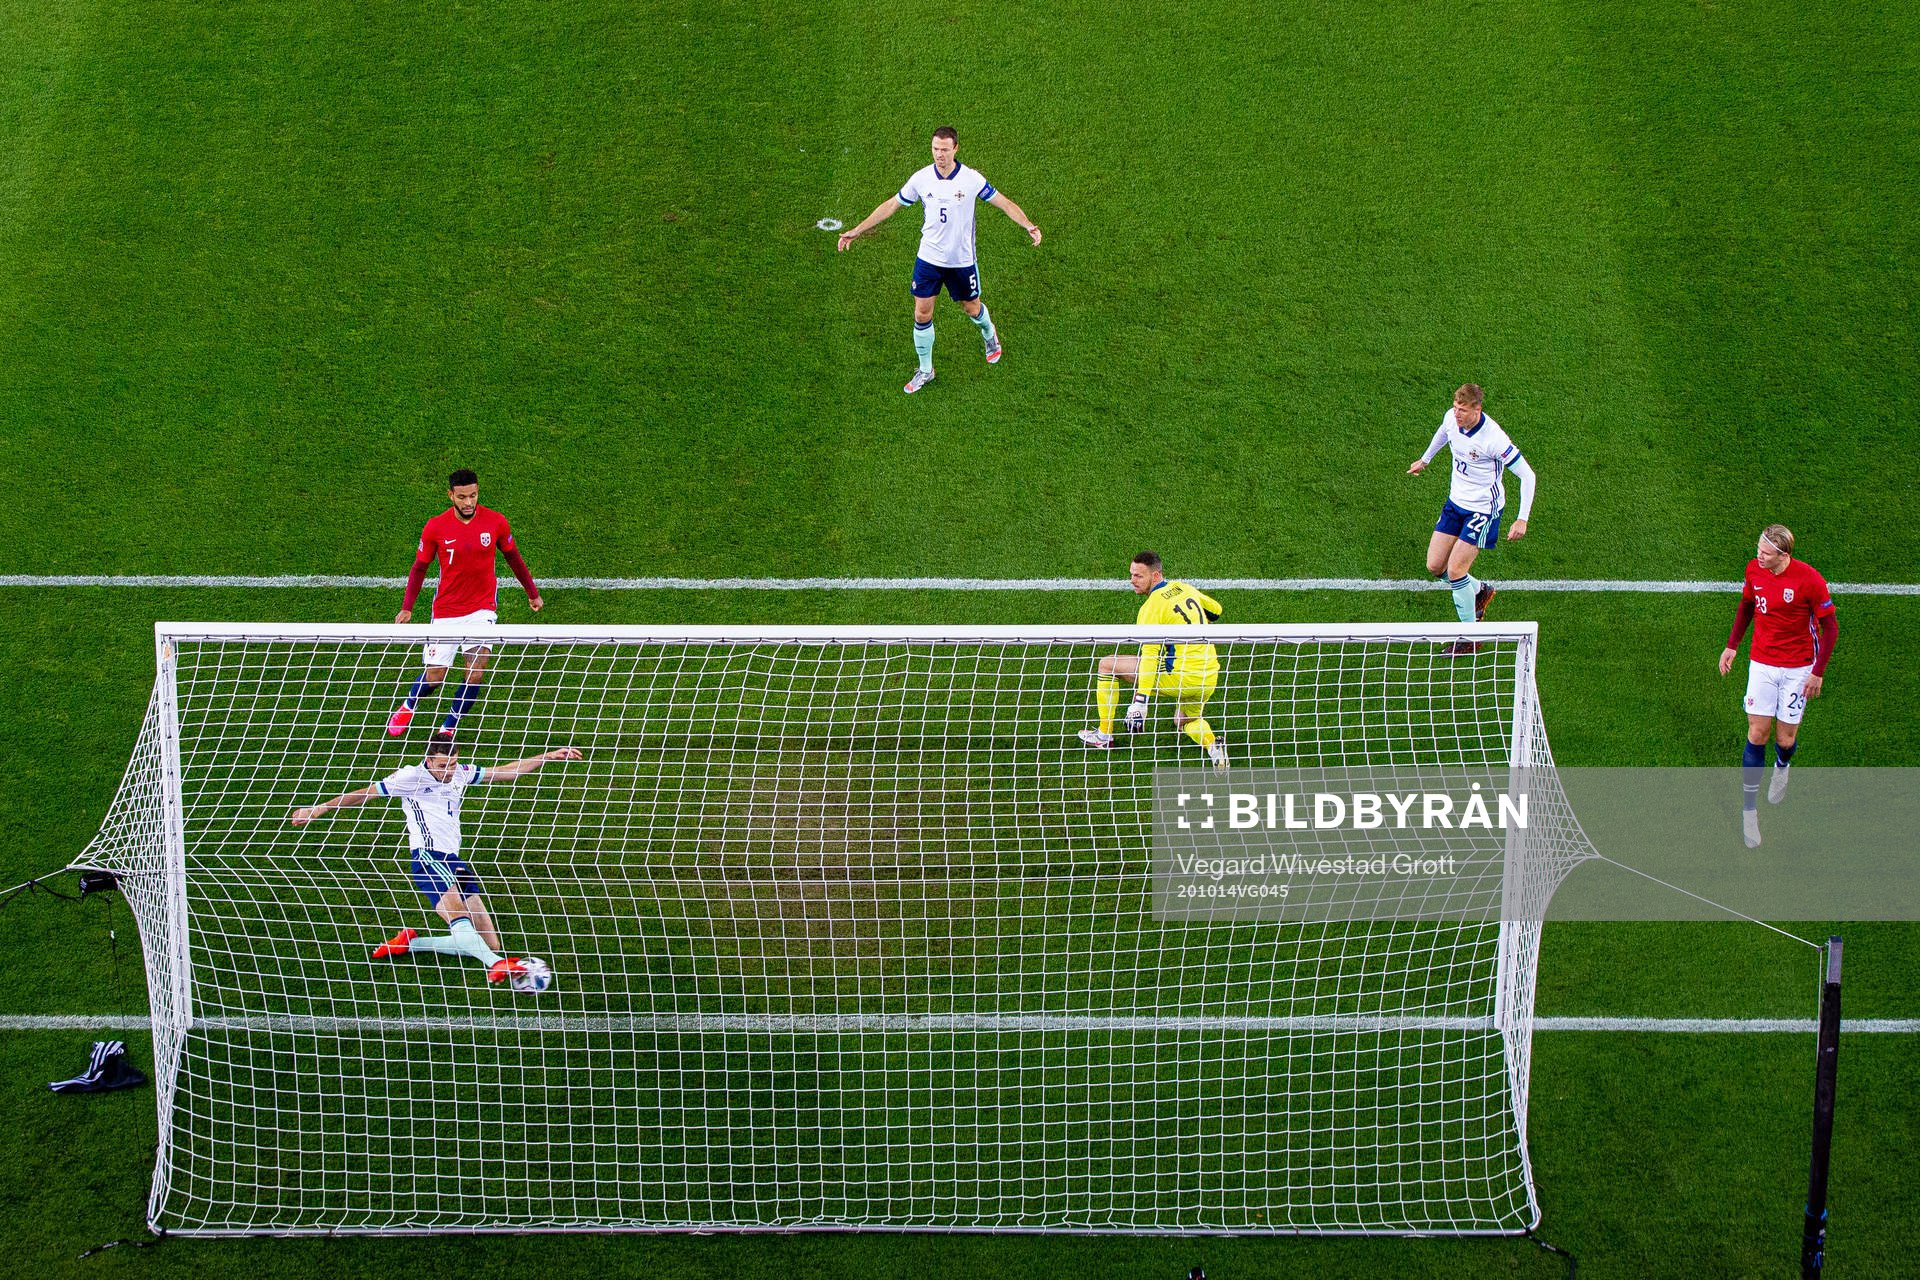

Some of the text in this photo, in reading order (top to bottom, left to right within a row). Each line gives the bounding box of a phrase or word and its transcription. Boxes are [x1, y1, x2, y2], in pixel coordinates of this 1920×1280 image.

[940, 207, 947, 223] 5
[969, 273, 977, 290] 5
[1467, 512, 1488, 532] 22
[446, 549, 455, 565] 7
[1755, 595, 1767, 614] 23
